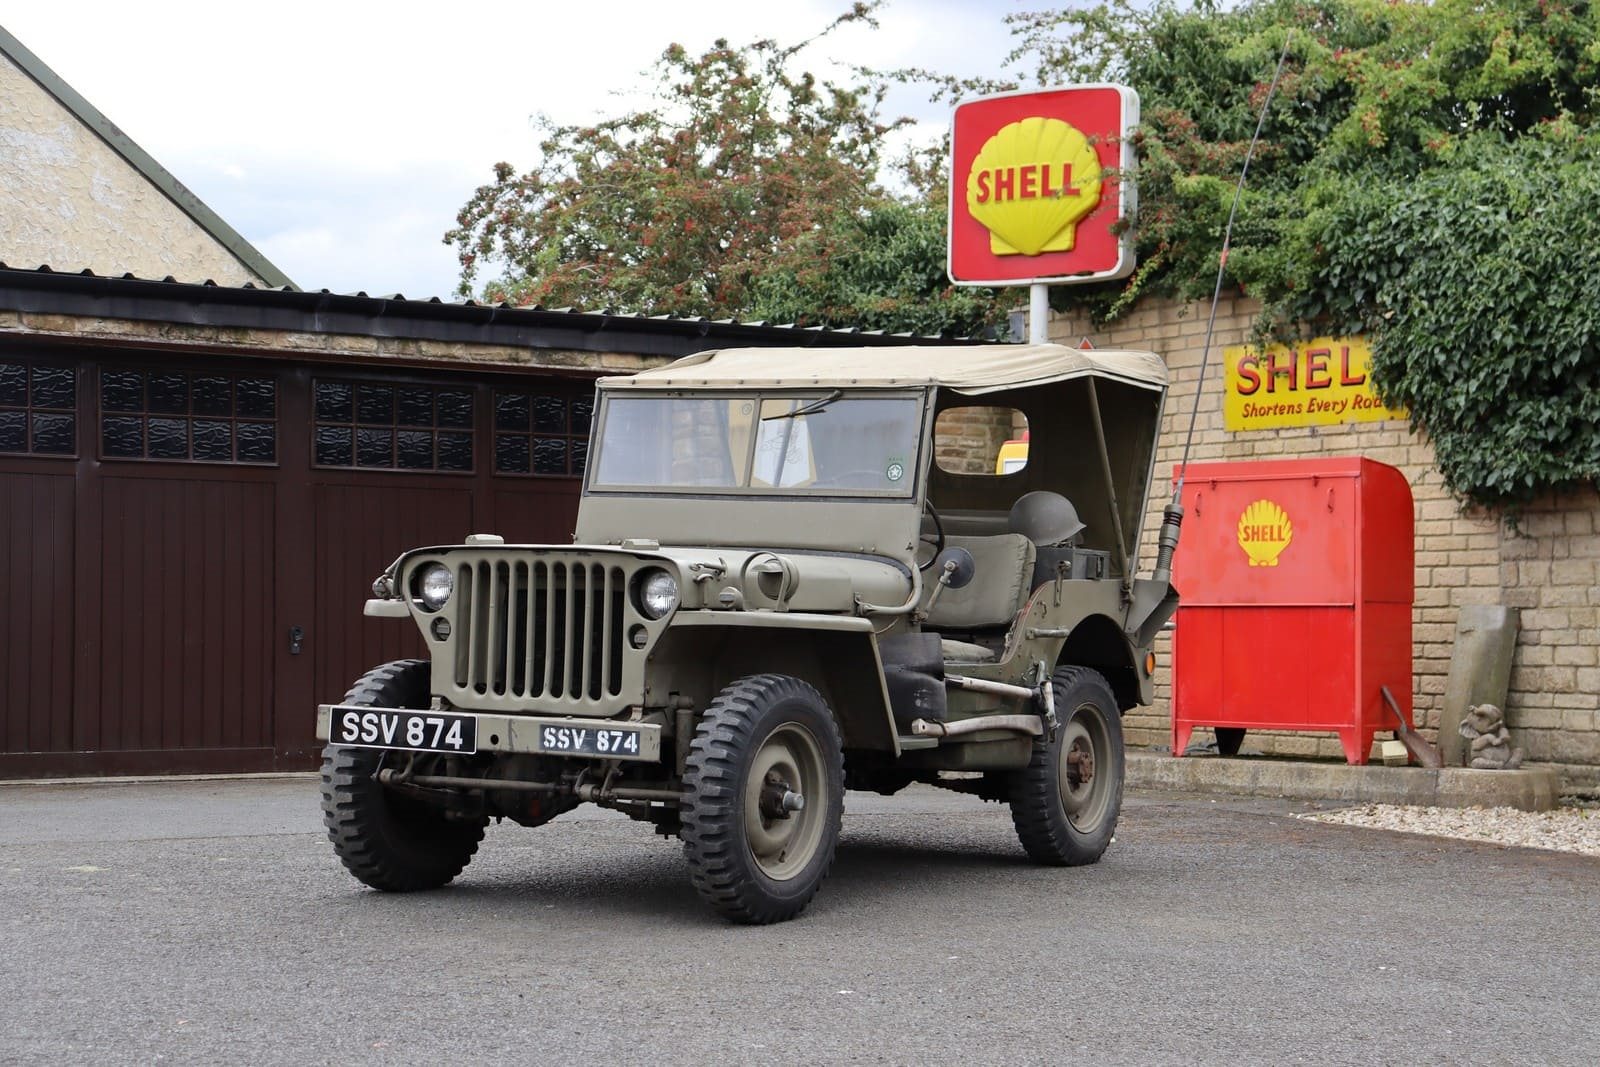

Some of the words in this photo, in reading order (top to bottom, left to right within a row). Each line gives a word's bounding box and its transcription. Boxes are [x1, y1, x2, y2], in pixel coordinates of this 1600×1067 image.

[976, 163, 1081, 205] SHELL
[1236, 346, 1367, 396] SHEL
[1242, 402, 1302, 418] Shortens
[1306, 397, 1348, 415] Every
[1352, 393, 1383, 410] Roa
[1243, 524, 1285, 542] SHELL
[342, 712, 399, 744] SSV
[406, 716, 463, 750] 874
[543, 727, 586, 750] SSV
[597, 730, 638, 753] 874
